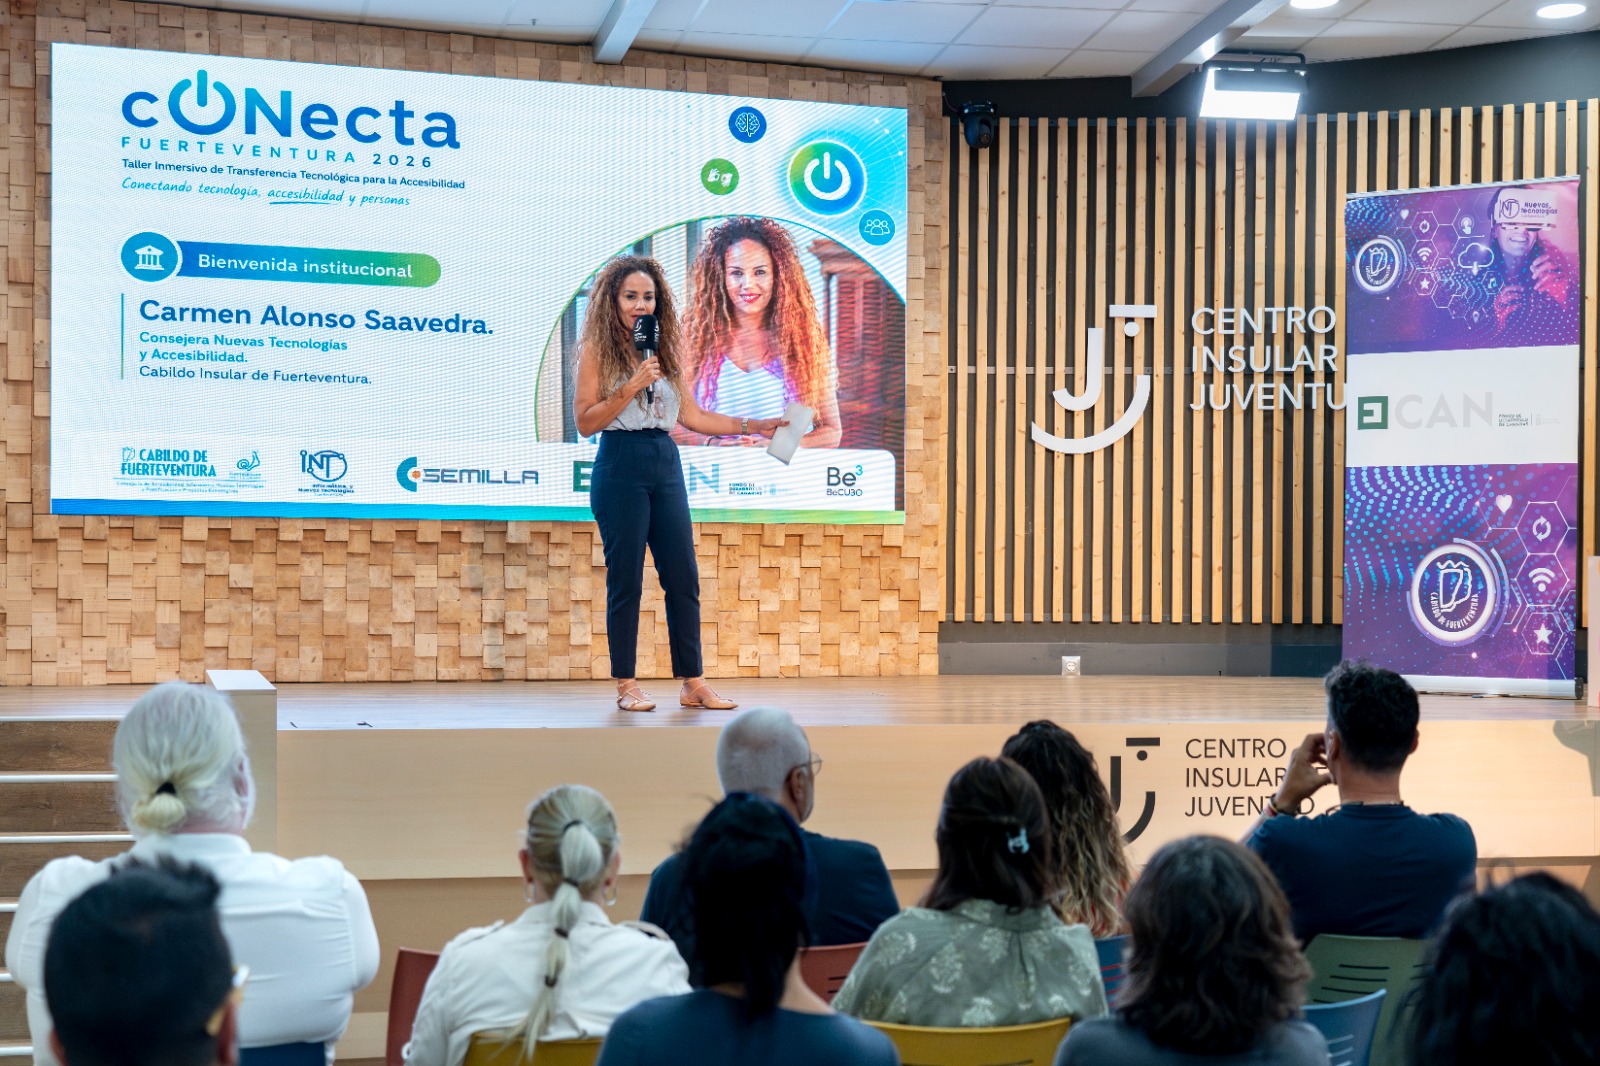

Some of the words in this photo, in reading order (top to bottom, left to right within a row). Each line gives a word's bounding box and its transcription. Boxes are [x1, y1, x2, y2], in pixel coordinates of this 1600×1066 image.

[121, 136, 356, 163] FUERTEVENTURA
[373, 153, 432, 168] 2026
[122, 158, 152, 170] Taller
[155, 161, 208, 174] Inmersivo
[210, 165, 224, 174] de
[226, 165, 297, 179] Transferencia
[300, 170, 360, 184] Tecnológica
[363, 176, 386, 186] para
[388, 176, 397, 185] la
[400, 177, 466, 190] Accesibilidad
[121, 177, 193, 193] Conectando
[267, 187, 345, 202] accesibilidad
[349, 195, 356, 207] y
[360, 194, 410, 207] personas
[198, 253, 299, 273] Bienvenida
[303, 259, 413, 279] institucional
[139, 299, 252, 325] Carmen
[260, 305, 356, 329] Alonso
[364, 309, 494, 336] Saavedra.
[1191, 305, 1337, 335] CENTRO
[139, 331, 210, 347] Consejera
[214, 334, 265, 348] Nuevas
[268, 336, 348, 352] Tecnologías
[139, 351, 147, 362] y
[151, 348, 249, 363] Accesibilidad.
[1191, 344, 1339, 373] INSULAR
[139, 365, 196, 379] Cabildo
[200, 367, 248, 381] Insular
[251, 369, 269, 381] de
[273, 370, 373, 385] Fuerteventura.
[1189, 382, 1348, 411] JUVENTU
[139, 448, 190, 462] CABILDO
[193, 450, 208, 463] DE
[120, 463, 217, 477] FUERTEVENTURA
[422, 468, 539, 485] SEMILLA
[1430, 591, 1442, 619] CABILDO
[1437, 615, 1447, 625] DE
[1445, 593, 1479, 629] FUERTEVENTURA
[1185, 738, 1287, 759] CENTRO
[1185, 766, 1288, 788] INSULAR
[1184, 795, 1315, 818] JUVEND
